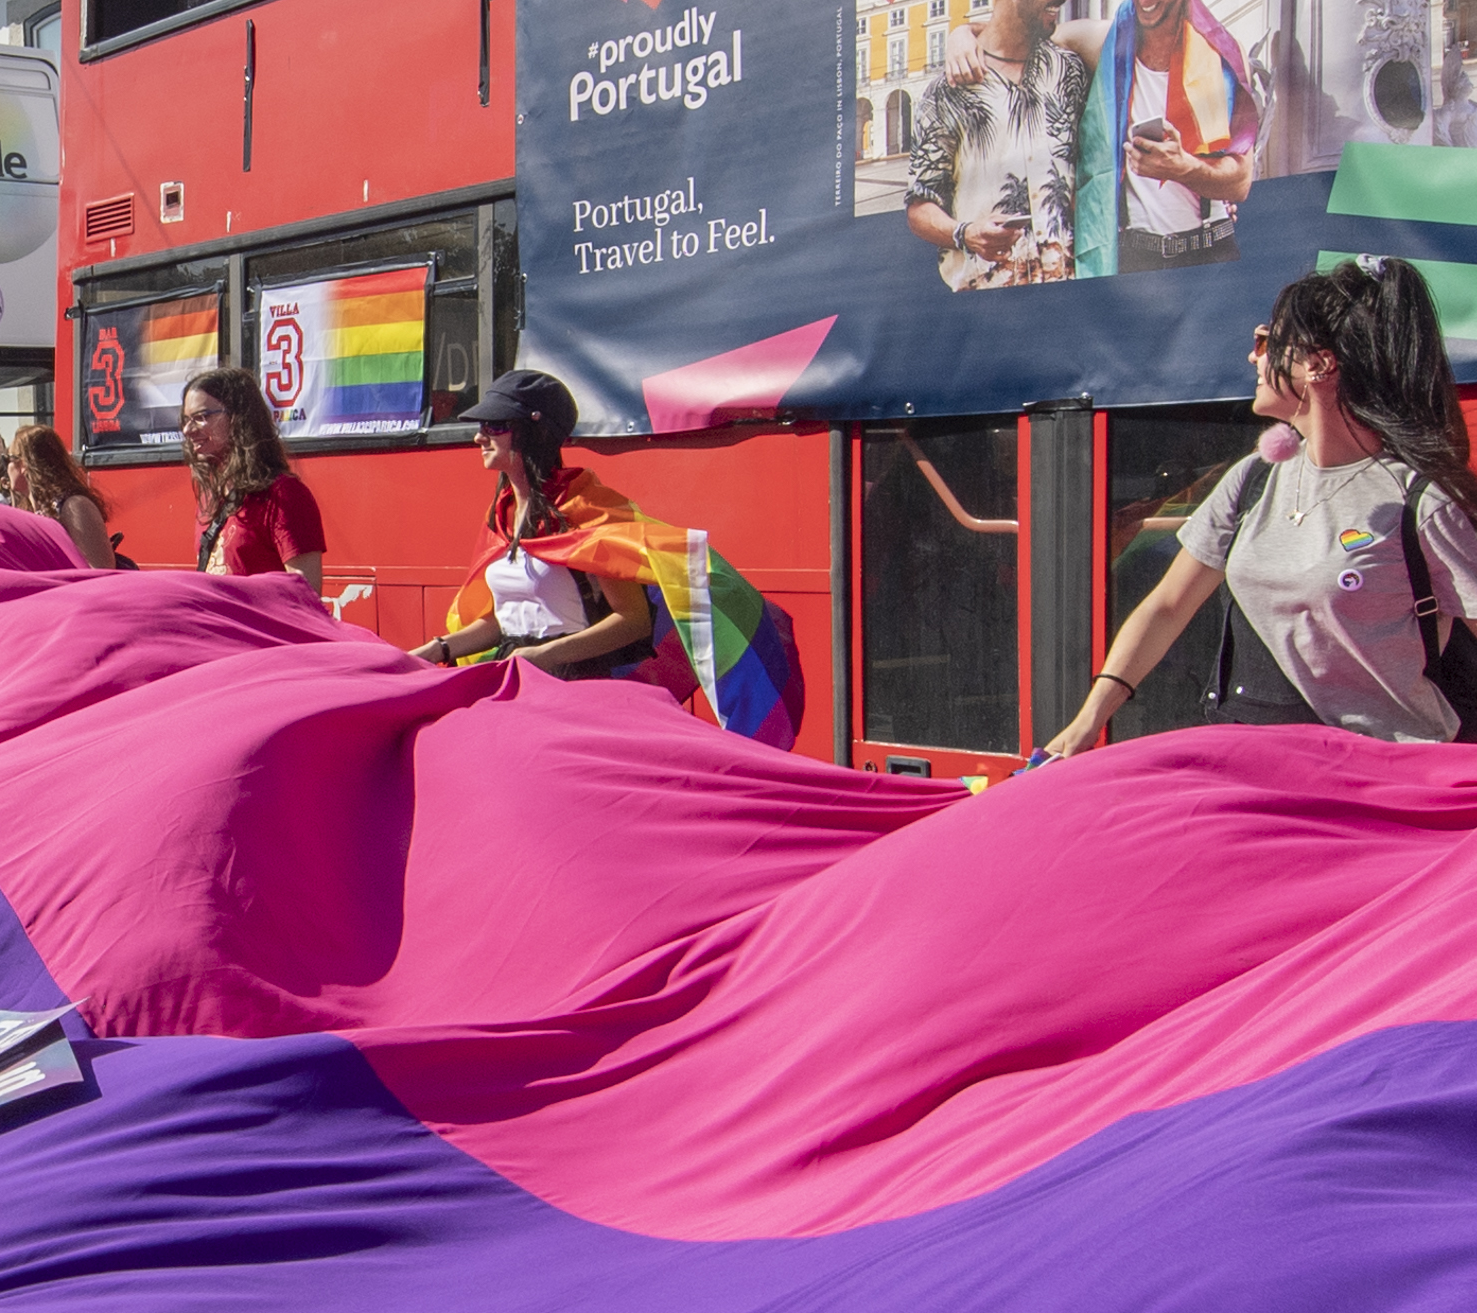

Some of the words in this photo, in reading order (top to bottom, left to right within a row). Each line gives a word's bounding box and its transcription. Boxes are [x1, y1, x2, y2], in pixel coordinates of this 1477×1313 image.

[588, 7, 717, 73] #proudly
[570, 30, 742, 122] Portugal
[573, 177, 703, 233] Portugal,
[574, 228, 664, 274] Travel
[671, 230, 699, 260] to
[706, 208, 775, 254] Feel.
[269, 302, 300, 318] VILLA
[89, 340, 125, 419] 3
[265, 317, 304, 408] 3
